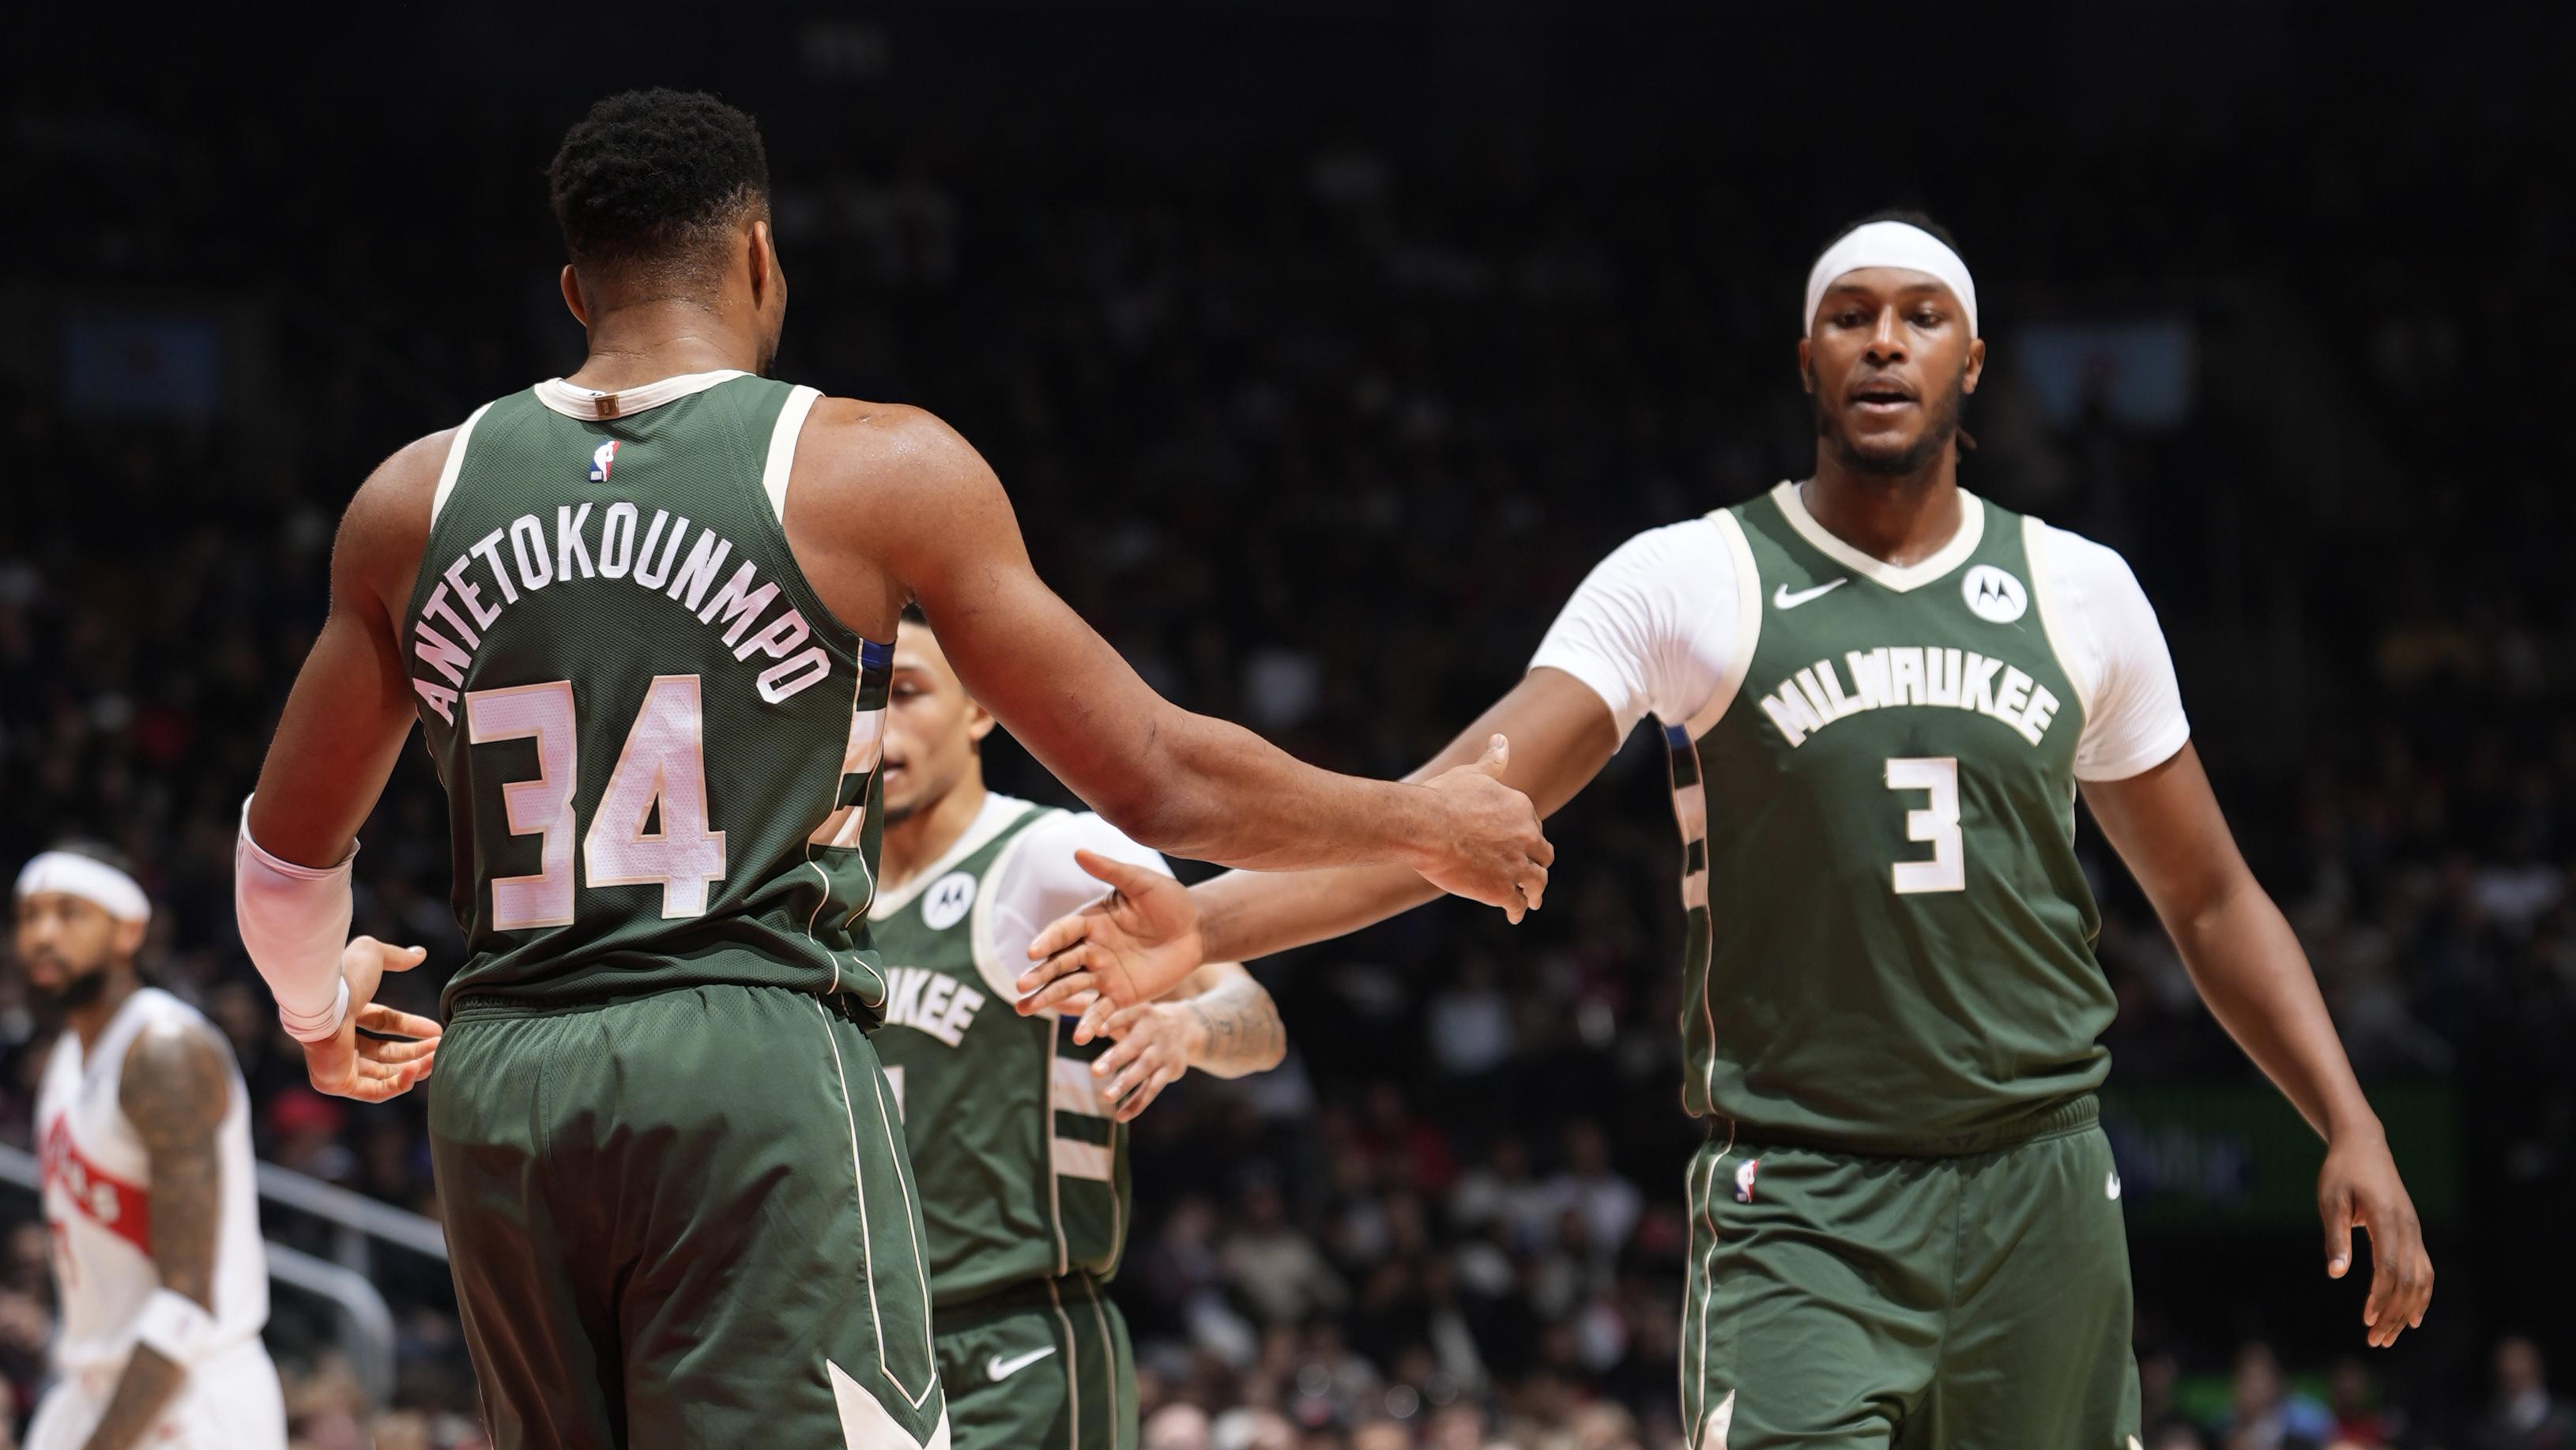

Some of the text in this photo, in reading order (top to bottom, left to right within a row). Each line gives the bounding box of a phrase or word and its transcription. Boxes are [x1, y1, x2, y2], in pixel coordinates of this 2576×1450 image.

[412, 502, 832, 727] ANTETOKOUNMPO
[1759, 646, 2061, 748] MILWAUKEE
[465, 673, 726, 932] 34
[1885, 756, 1966, 894] 3
